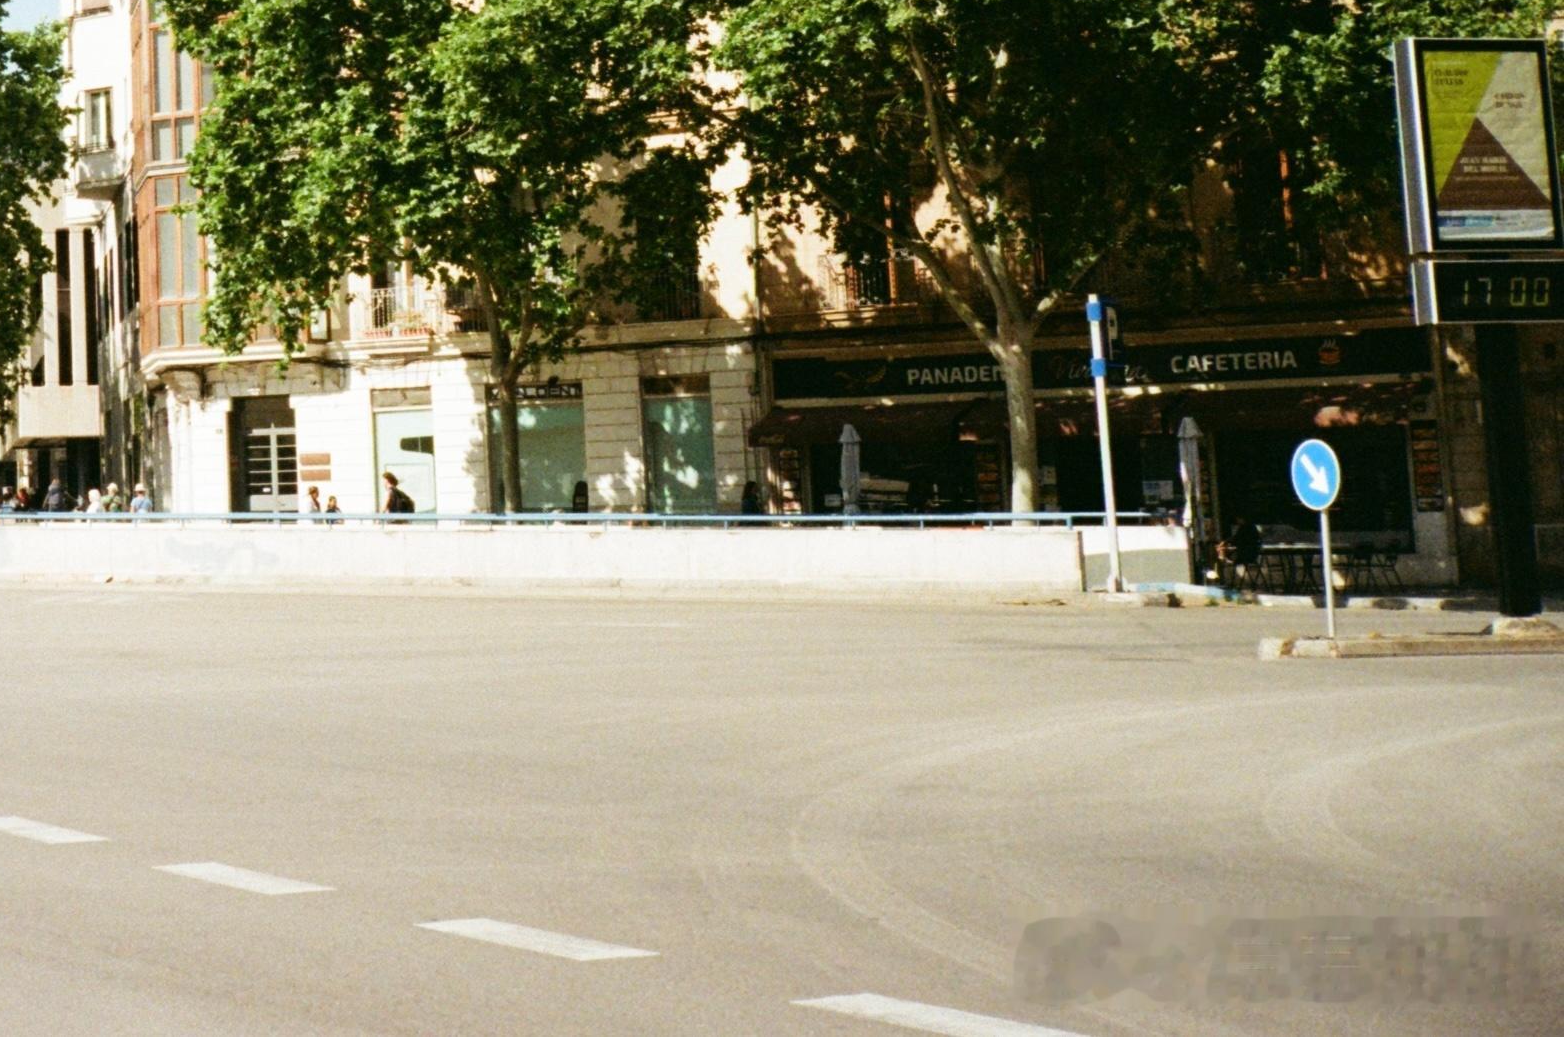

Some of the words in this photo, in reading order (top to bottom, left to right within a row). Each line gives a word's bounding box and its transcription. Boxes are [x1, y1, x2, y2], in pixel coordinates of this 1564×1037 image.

[1462, 277, 1492, 306] 17
[1509, 277, 1550, 306] 00
[906, 364, 1008, 386] PANADER
[1170, 349, 1298, 374] CAFETERIA
